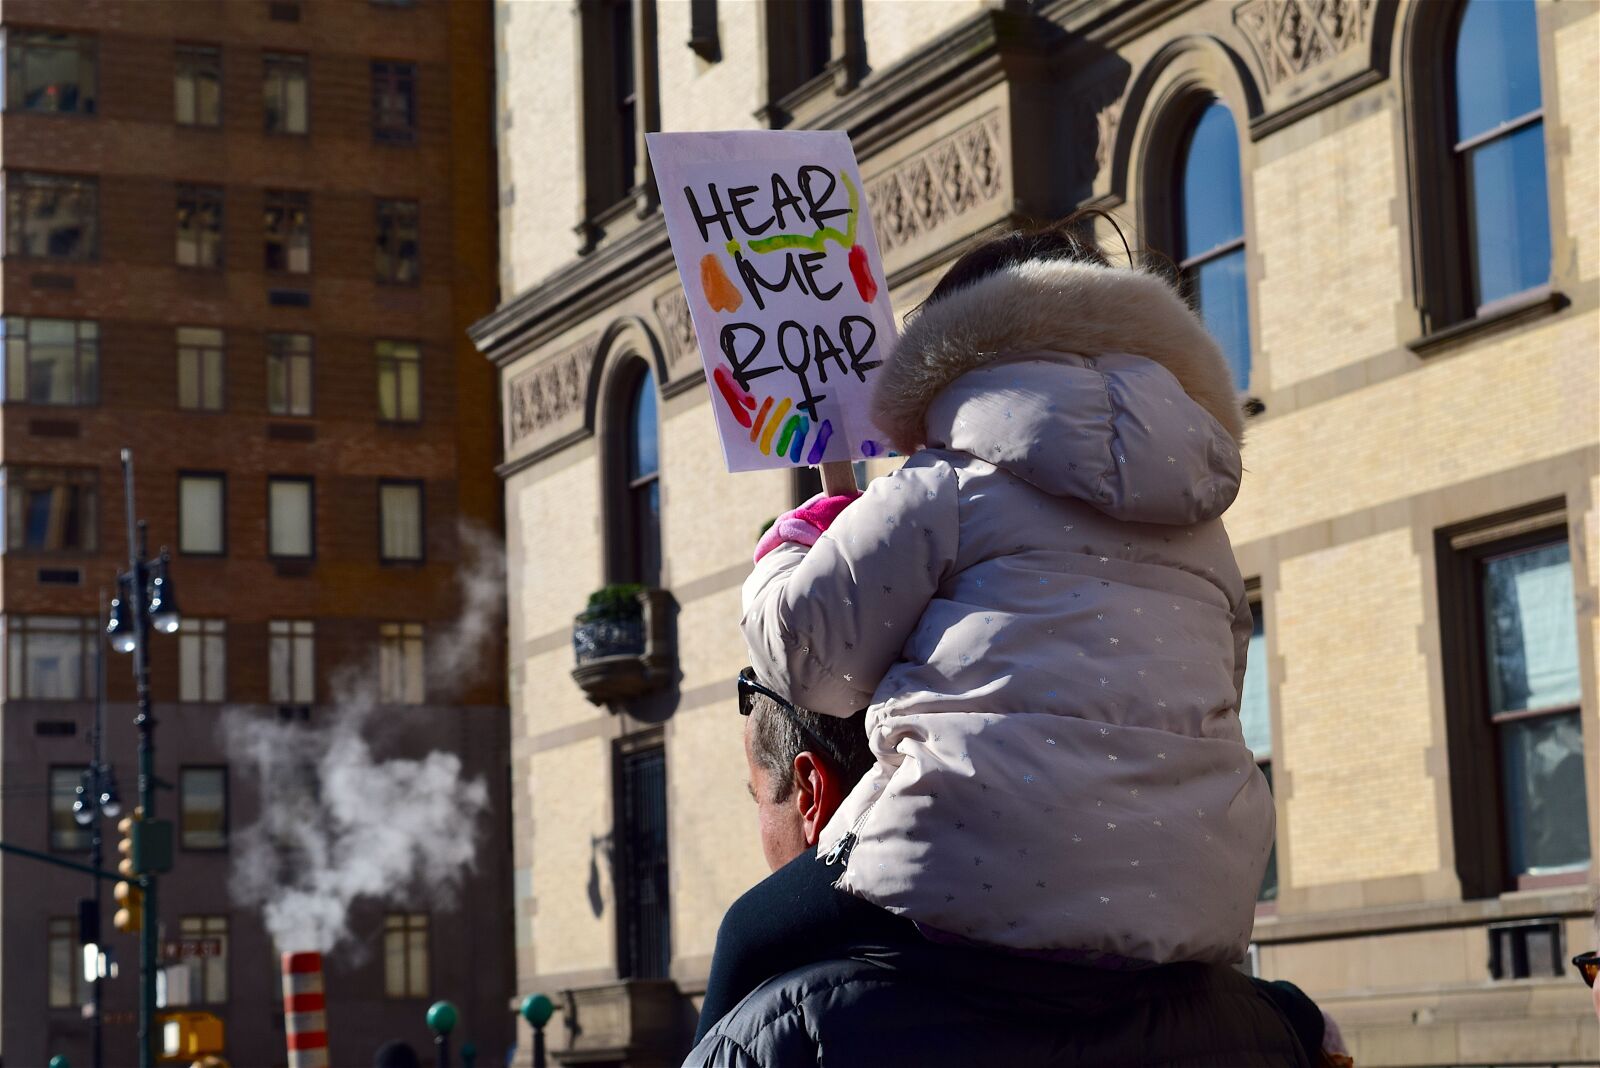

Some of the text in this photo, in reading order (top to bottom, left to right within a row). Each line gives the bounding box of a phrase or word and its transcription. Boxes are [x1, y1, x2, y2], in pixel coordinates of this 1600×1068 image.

[684, 165, 853, 242] HEAR
[735, 250, 843, 310] ME
[720, 316, 883, 395] ROAR
